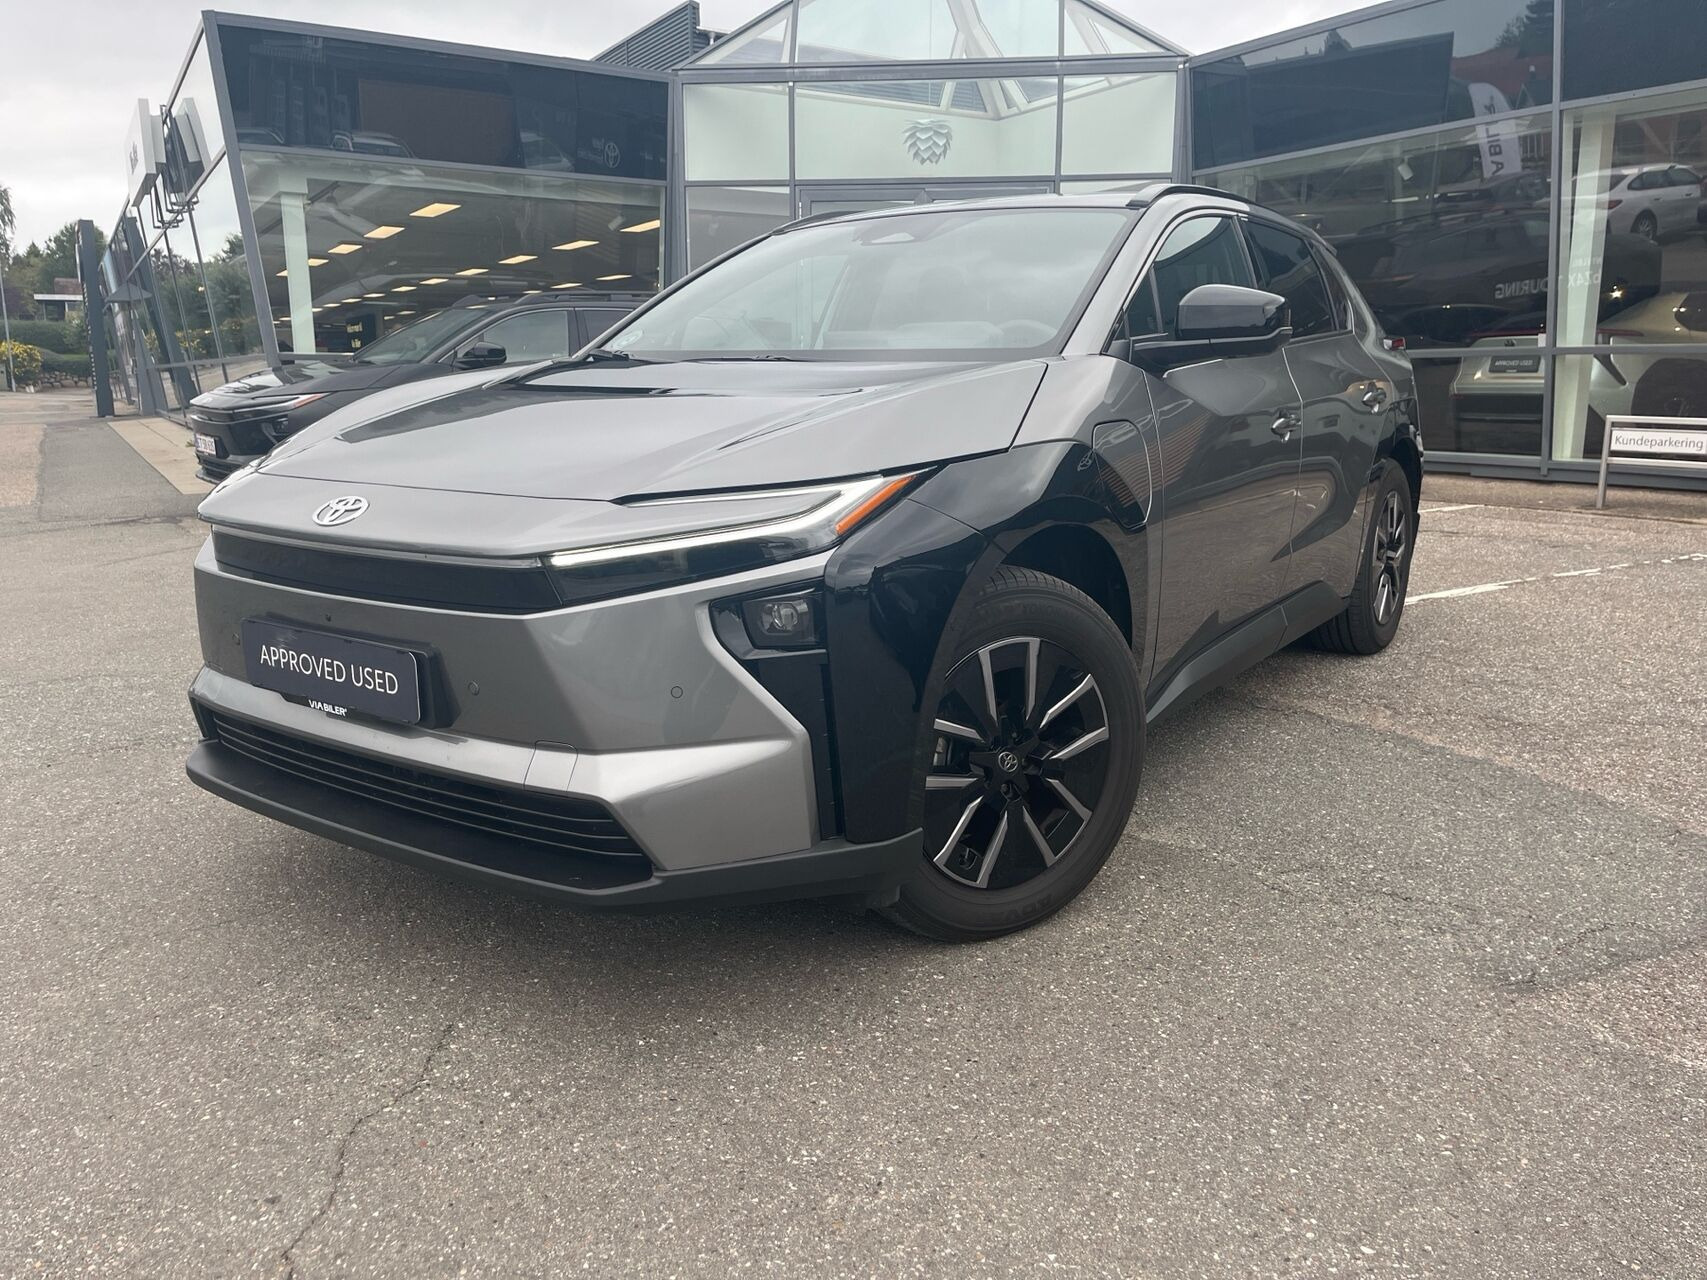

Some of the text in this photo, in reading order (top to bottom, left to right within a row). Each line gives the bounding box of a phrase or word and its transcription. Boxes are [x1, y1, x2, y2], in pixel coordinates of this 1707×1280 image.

[1614, 434, 1704, 452] Kundeparkering
[260, 645, 399, 695] APPROVED USED
